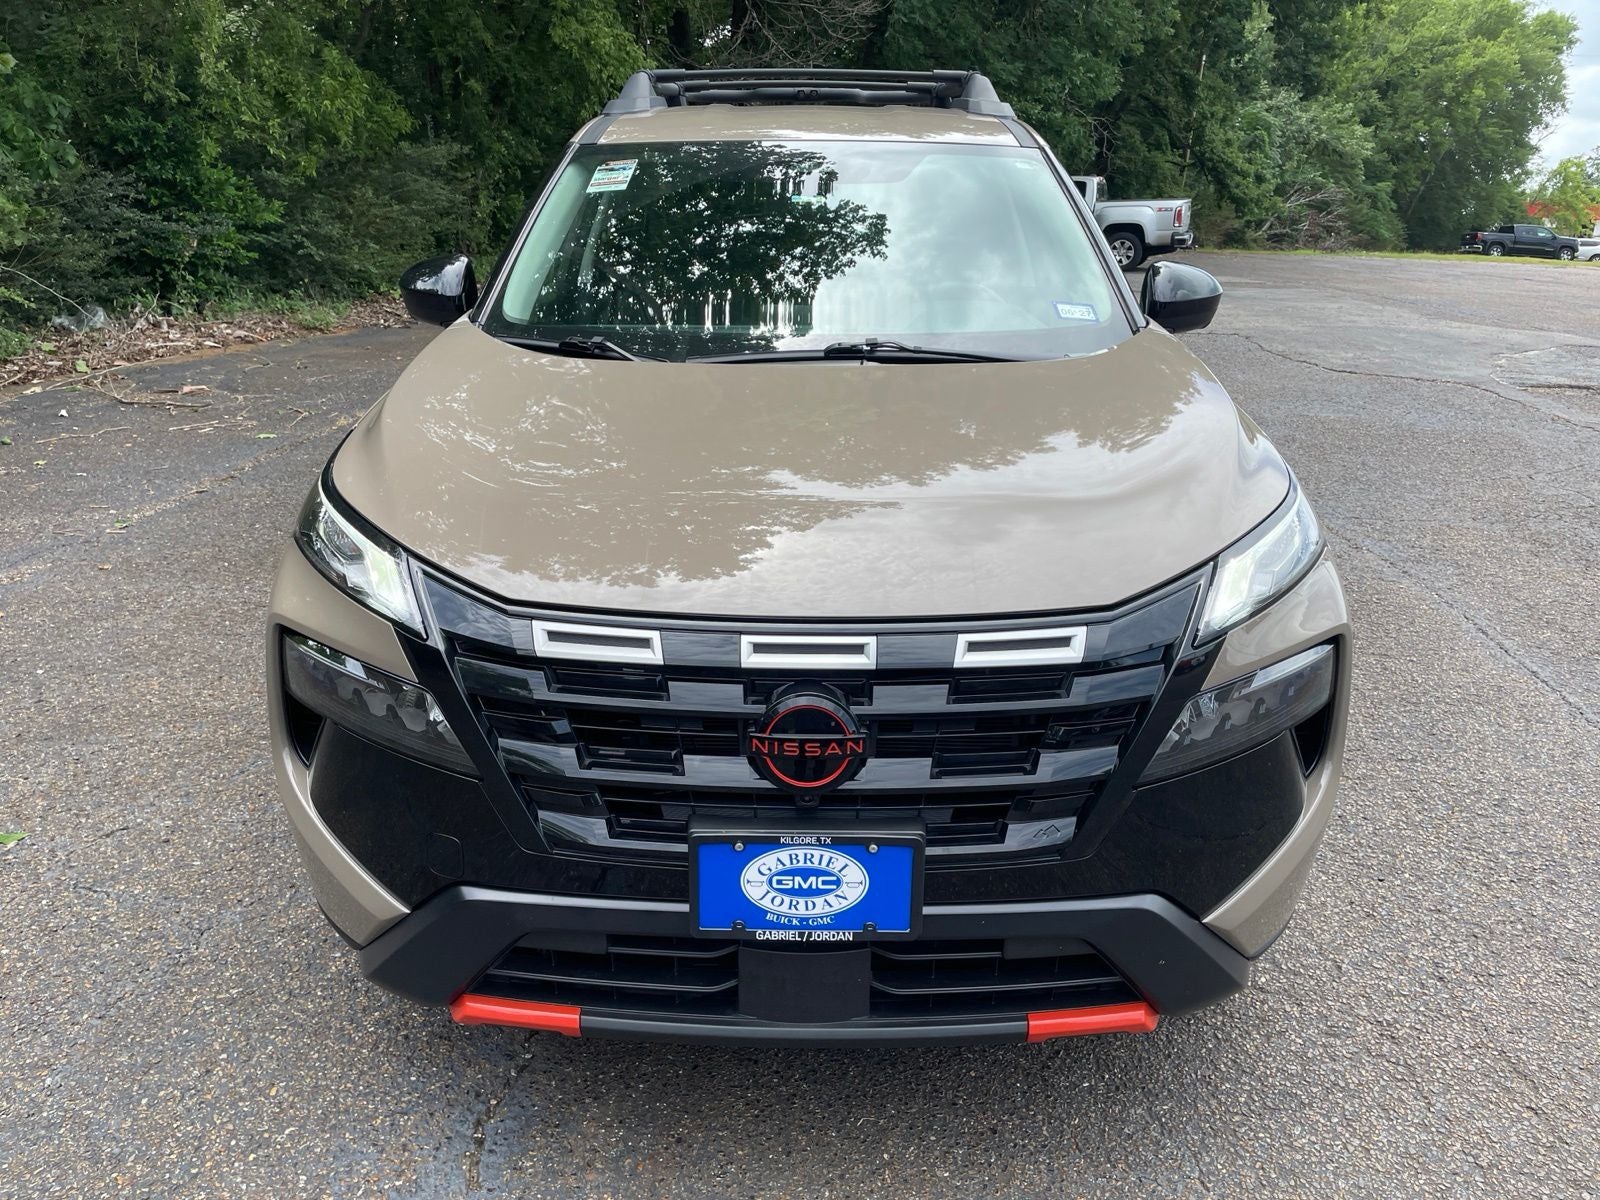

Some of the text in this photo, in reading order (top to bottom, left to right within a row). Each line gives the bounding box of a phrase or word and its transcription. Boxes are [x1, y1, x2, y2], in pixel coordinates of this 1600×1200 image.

[751, 738, 863, 756] NISSAN
[757, 852, 850, 878] GABRIEL
[772, 875, 838, 890] GMC
[757, 889, 850, 912] JORDAN
[765, 912, 801, 926] BUICK
[809, 915, 836, 926] GMC
[755, 931, 802, 941] GABRIEL
[809, 931, 853, 942] JORDAN
